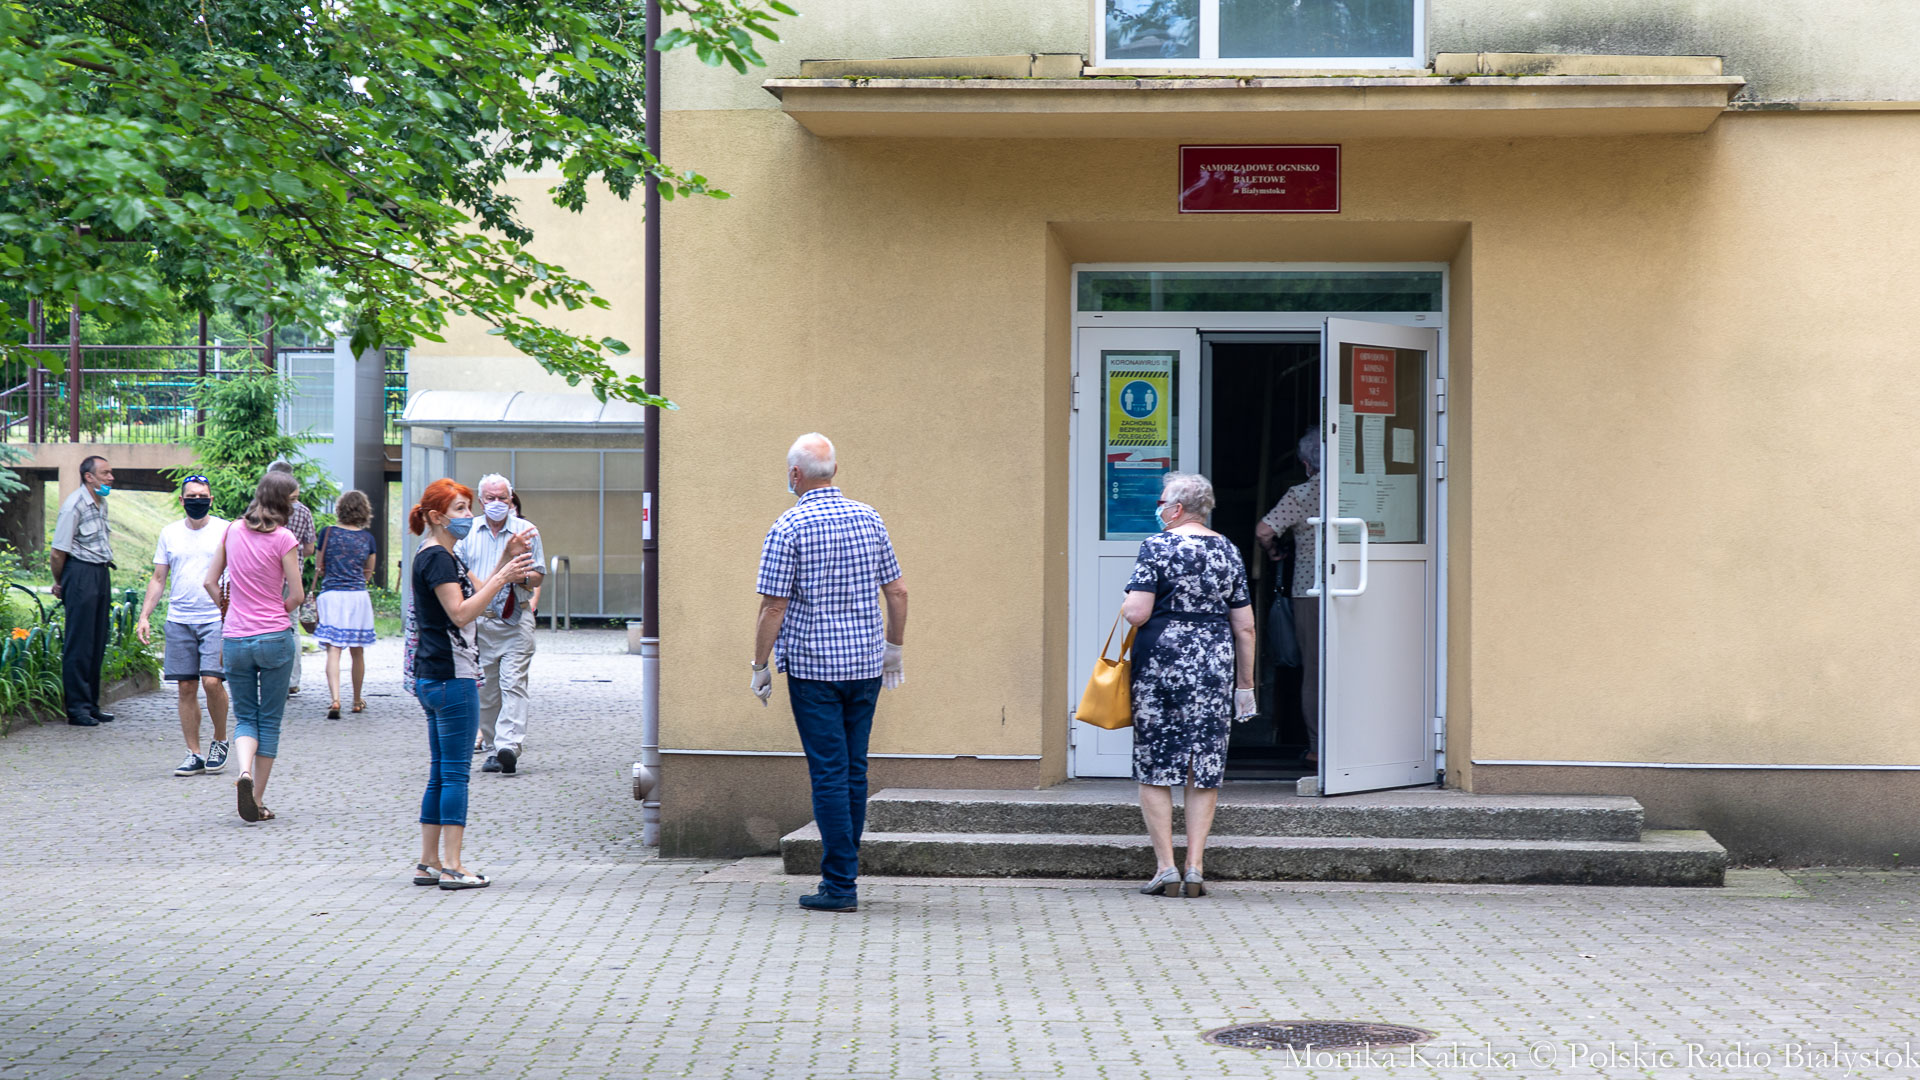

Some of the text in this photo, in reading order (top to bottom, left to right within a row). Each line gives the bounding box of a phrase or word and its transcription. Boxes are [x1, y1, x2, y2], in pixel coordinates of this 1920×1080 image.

[1200, 164, 1320, 174] SAMORZĄDOWE OGNISKO
[1241, 187, 1286, 196] Białymstoku
[1360, 375, 1388, 384] WYBORCZA
